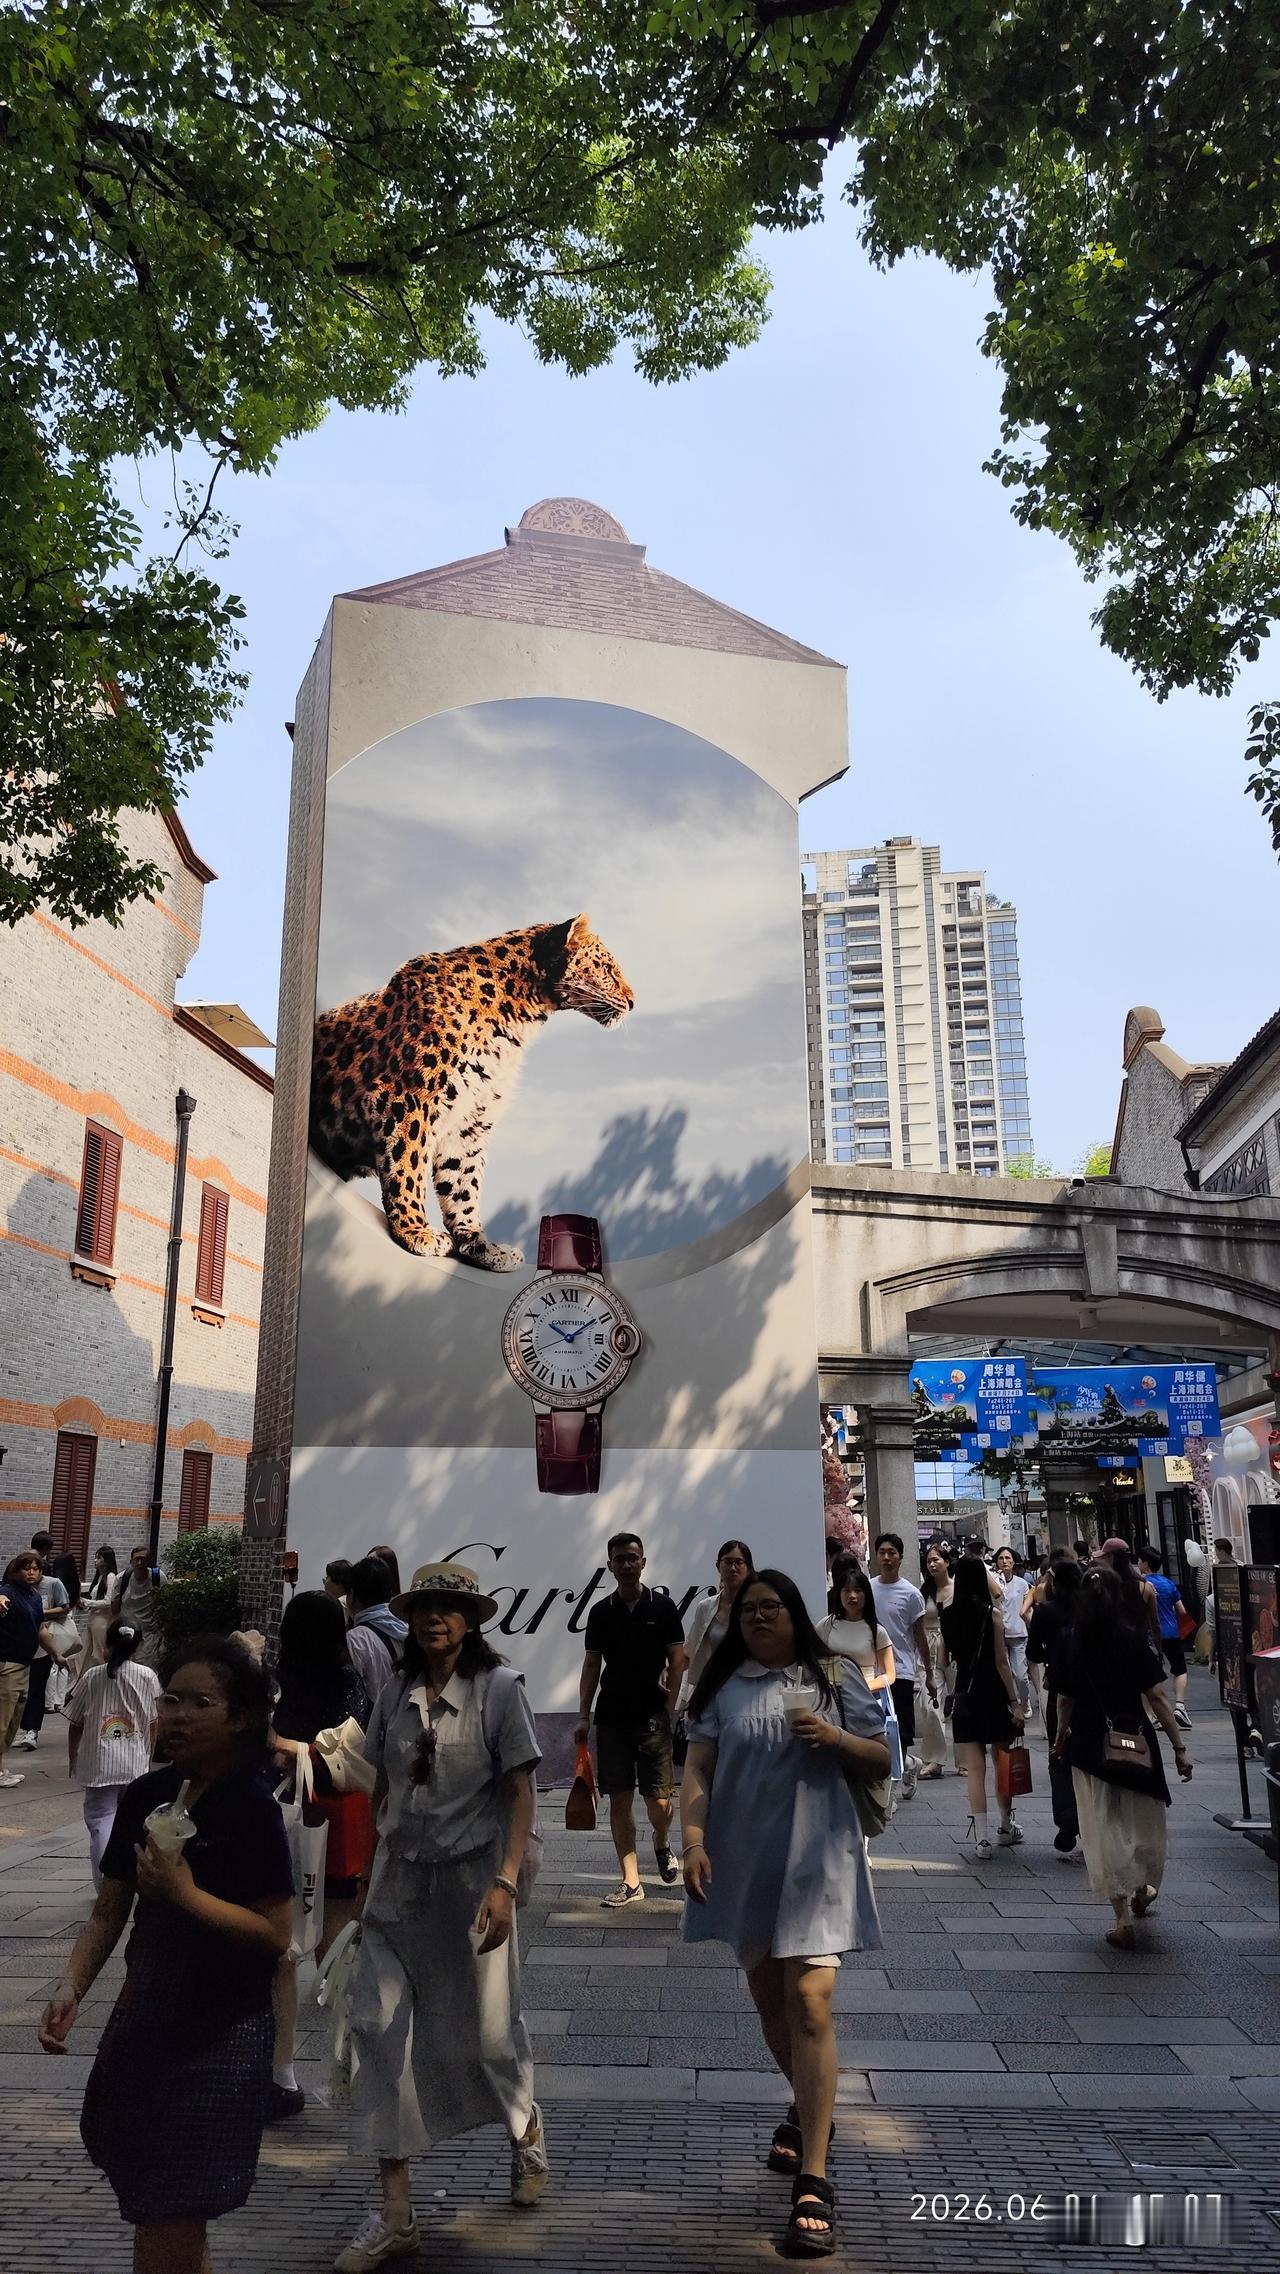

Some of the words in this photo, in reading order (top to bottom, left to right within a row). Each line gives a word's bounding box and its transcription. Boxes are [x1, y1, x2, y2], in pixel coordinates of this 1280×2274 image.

[560, 1288, 579, 1303] XII
[983, 1363, 1016, 1377] 周华健
[1174, 1370, 1206, 1383] 周华健
[978, 1378, 1022, 1390] 上海演唱会
[1169, 1383, 1213, 1395] 上海演唱会
[303, 1873, 316, 1915] FILA
